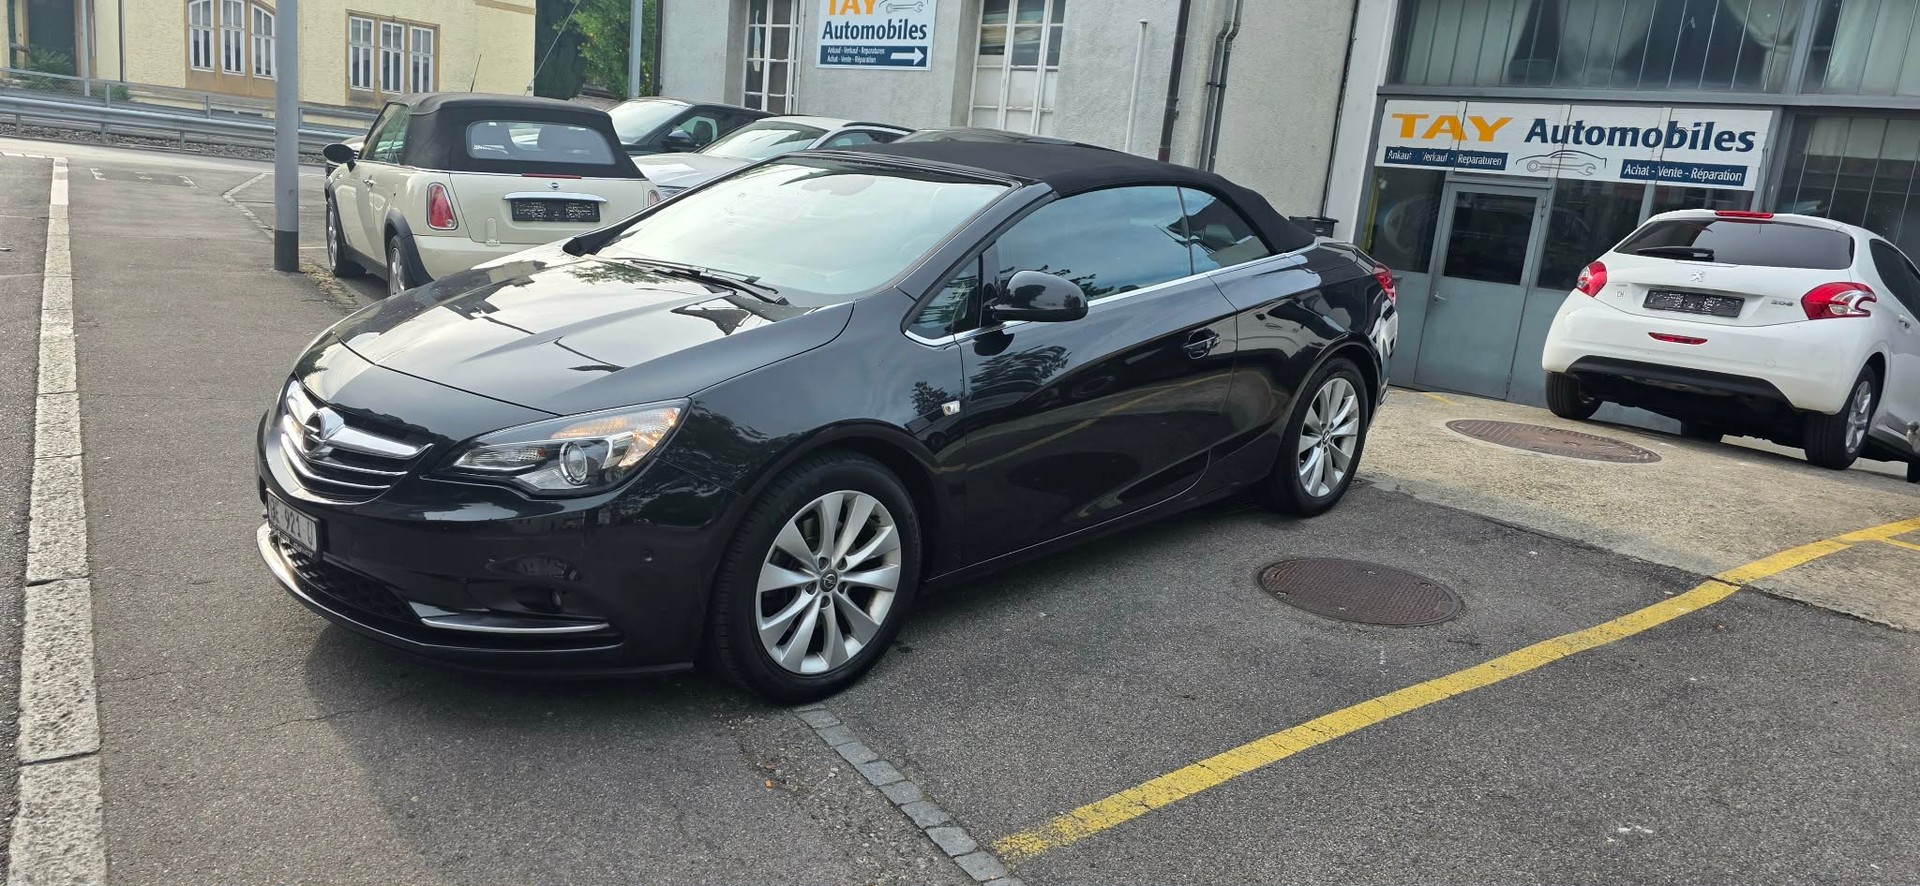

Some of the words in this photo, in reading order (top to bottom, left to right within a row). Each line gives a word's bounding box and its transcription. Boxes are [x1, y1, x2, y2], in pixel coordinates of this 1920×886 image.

[822, 18, 928, 40] Automobiles
[1391, 113, 1515, 142] TAY
[1524, 118, 1756, 153] Automobiles
[1457, 153, 1503, 166] Reparaturen
[1623, 163, 1650, 176] Achat
[1657, 165, 1683, 178] Vente
[1690, 167, 1743, 182] Réparation
[285, 508, 301, 538] 921
[307, 521, 314, 547] U
